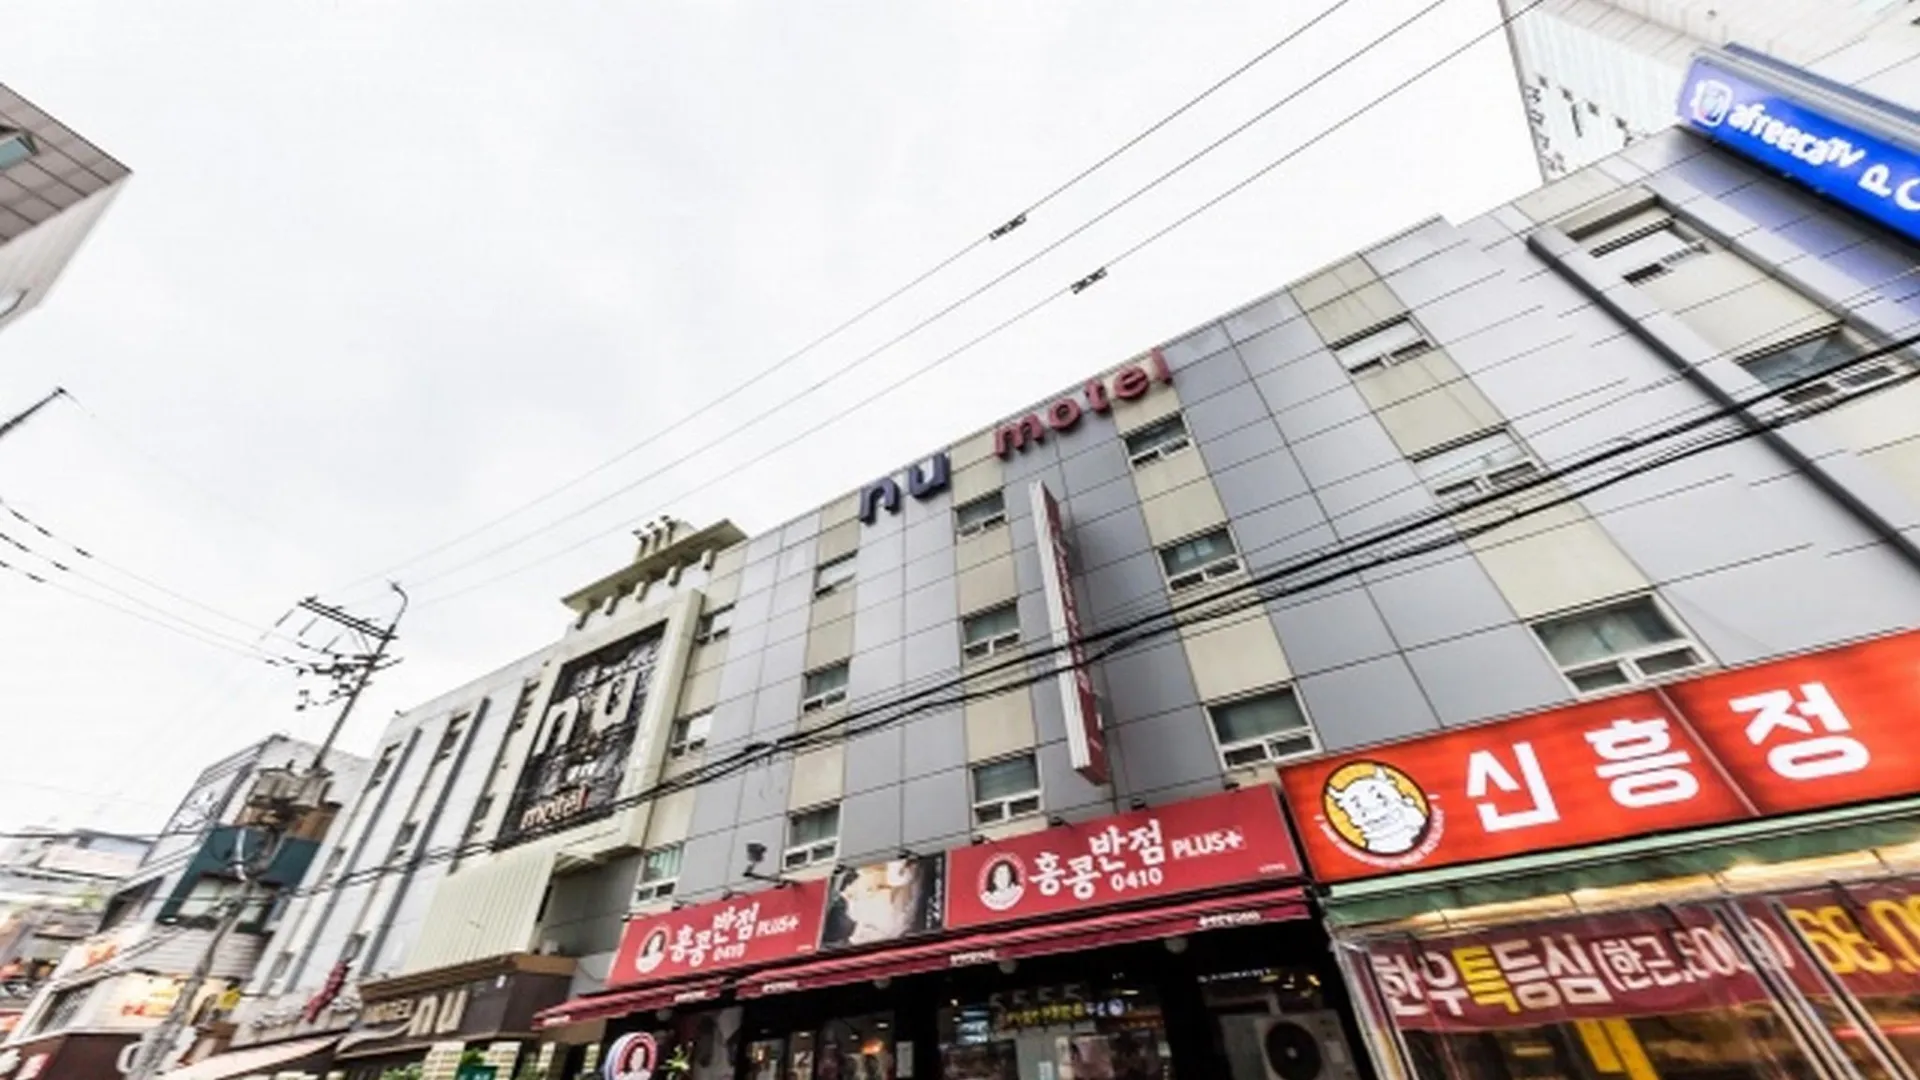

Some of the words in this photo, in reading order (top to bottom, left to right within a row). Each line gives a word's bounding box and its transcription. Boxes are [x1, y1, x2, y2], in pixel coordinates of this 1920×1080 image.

[1727, 102, 1867, 169] afreecaTV
[858, 452, 951, 524] nu
[992, 348, 1173, 459] motel
[534, 671, 638, 757] nu
[1465, 681, 1871, 833] 신흥정
[520, 780, 591, 830] motel
[1029, 818, 1167, 900] 홍콩반점
[1110, 867, 1164, 892] 0410
[669, 902, 761, 968] 홍콩반점
[1371, 933, 1613, 1017] 한우특등심
[407, 988, 469, 1038] nu
